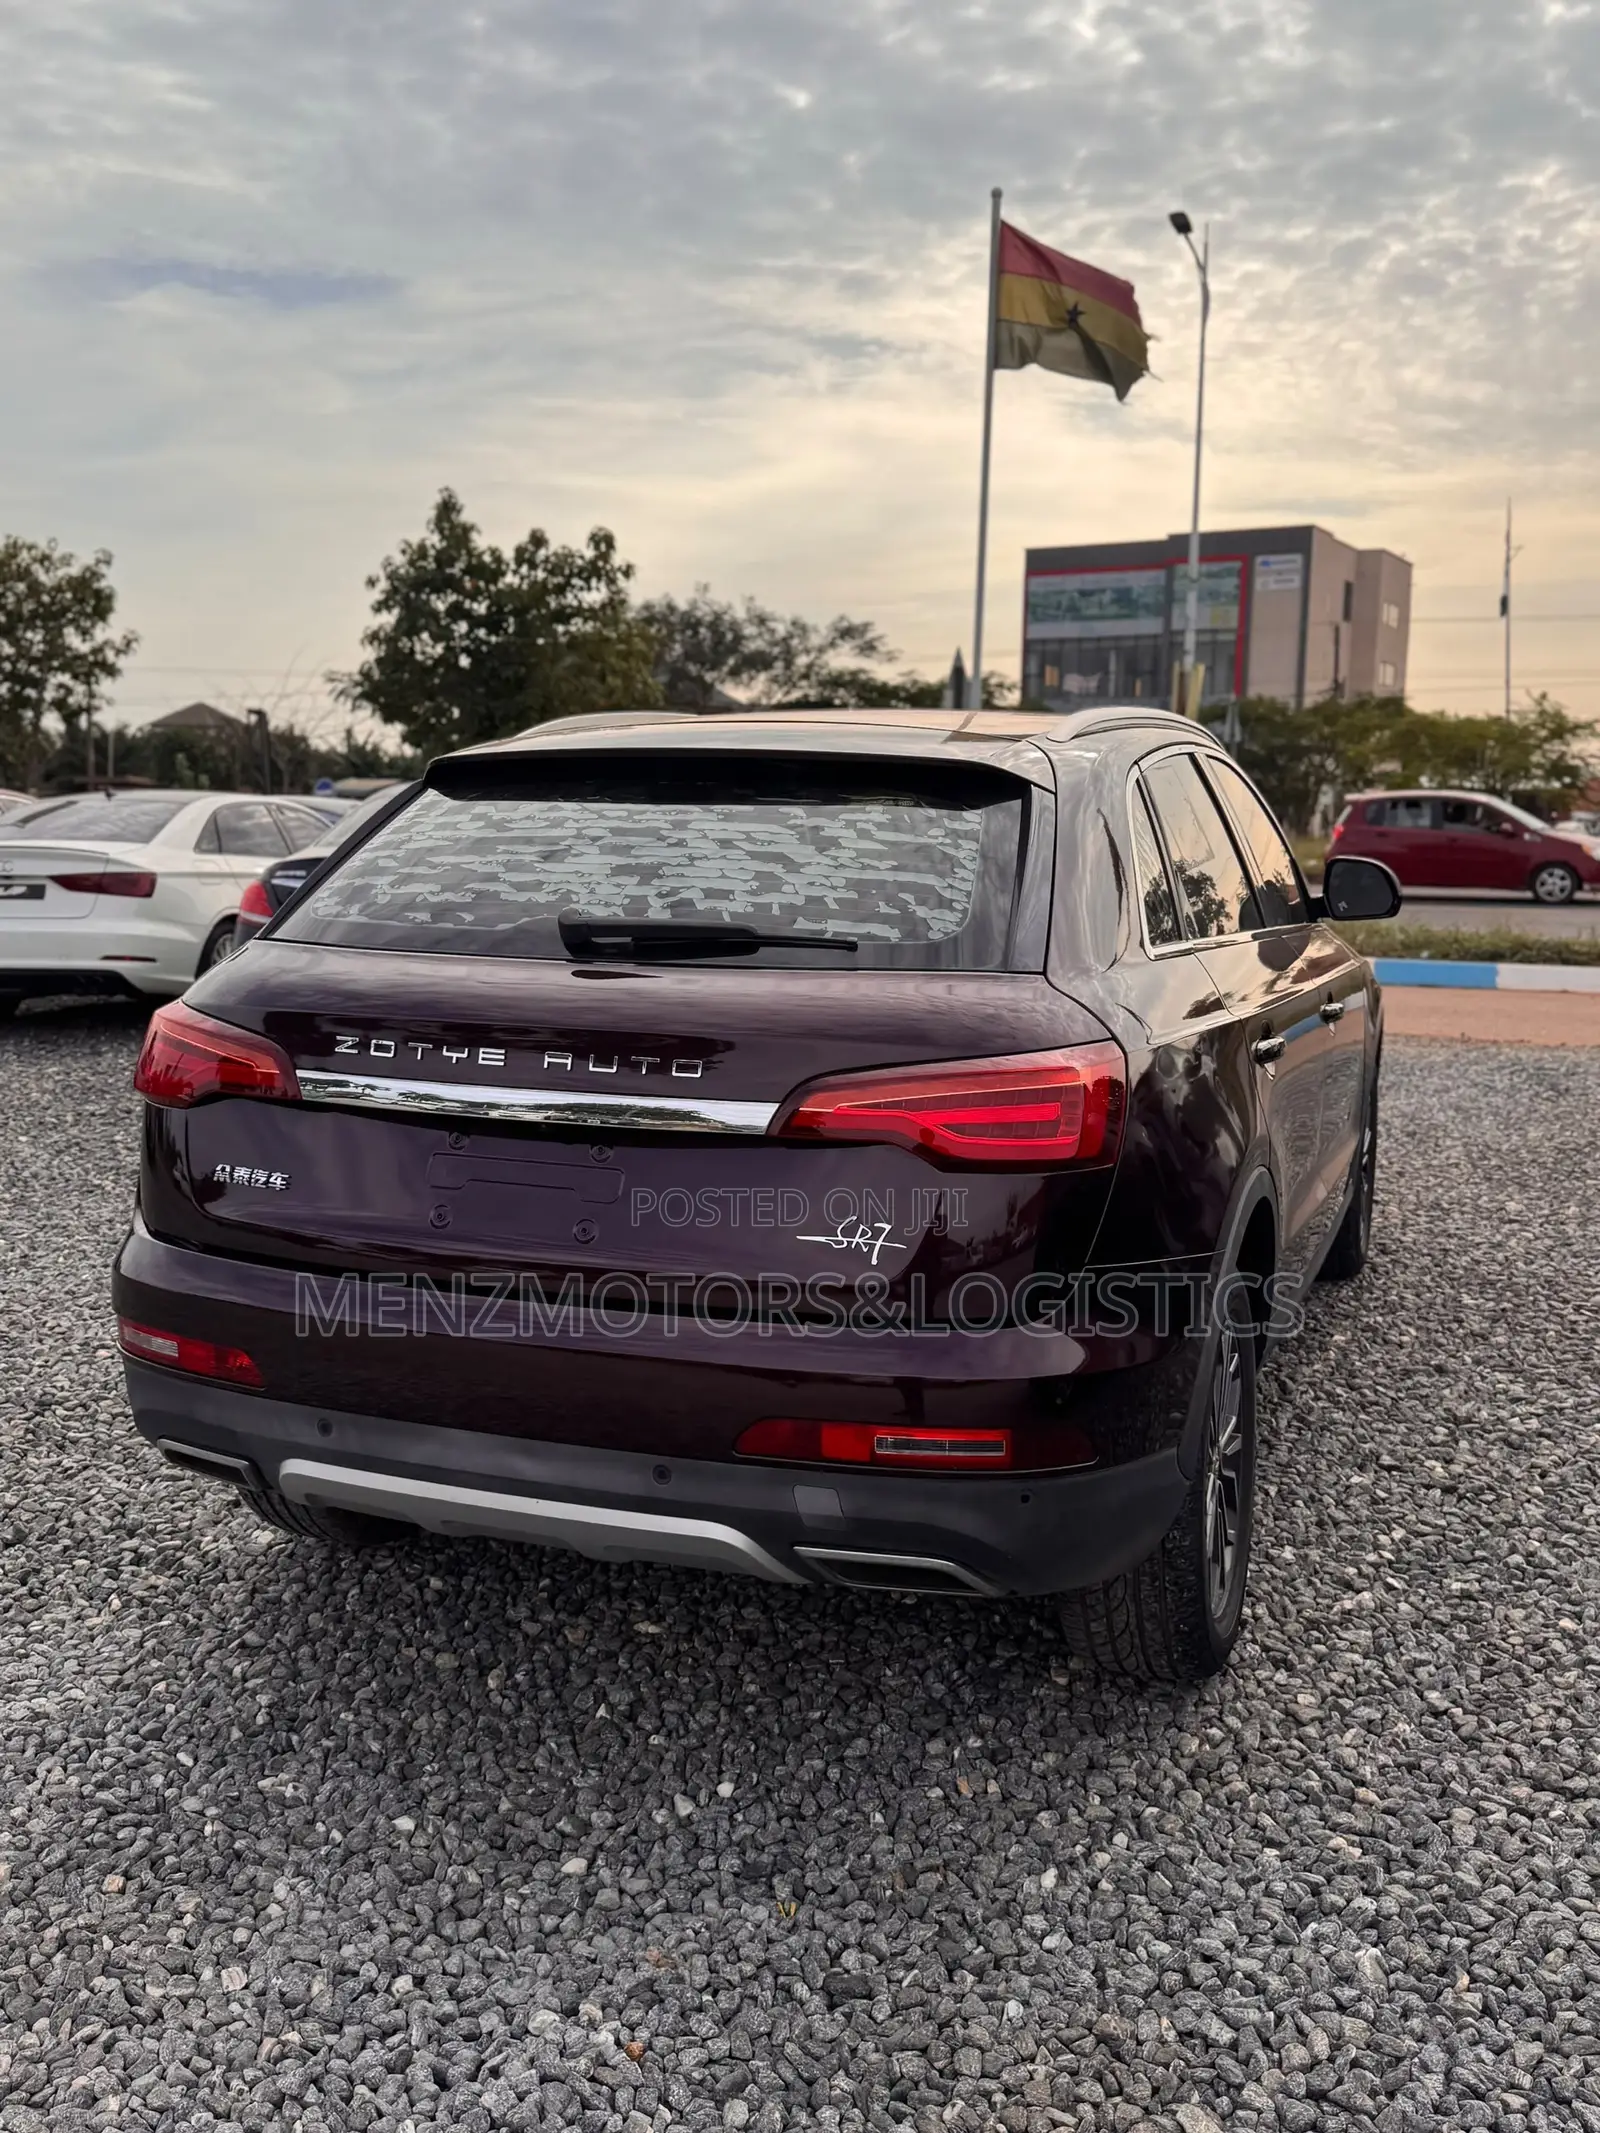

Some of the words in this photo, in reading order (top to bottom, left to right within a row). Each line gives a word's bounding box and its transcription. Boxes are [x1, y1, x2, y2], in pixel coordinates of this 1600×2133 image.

[334, 1036, 506, 1066] ZOTYE
[543, 1051, 703, 1078] AUTO
[213, 1163, 290, 1191] 众泰汽车
[796, 1215, 907, 1265] SR7
